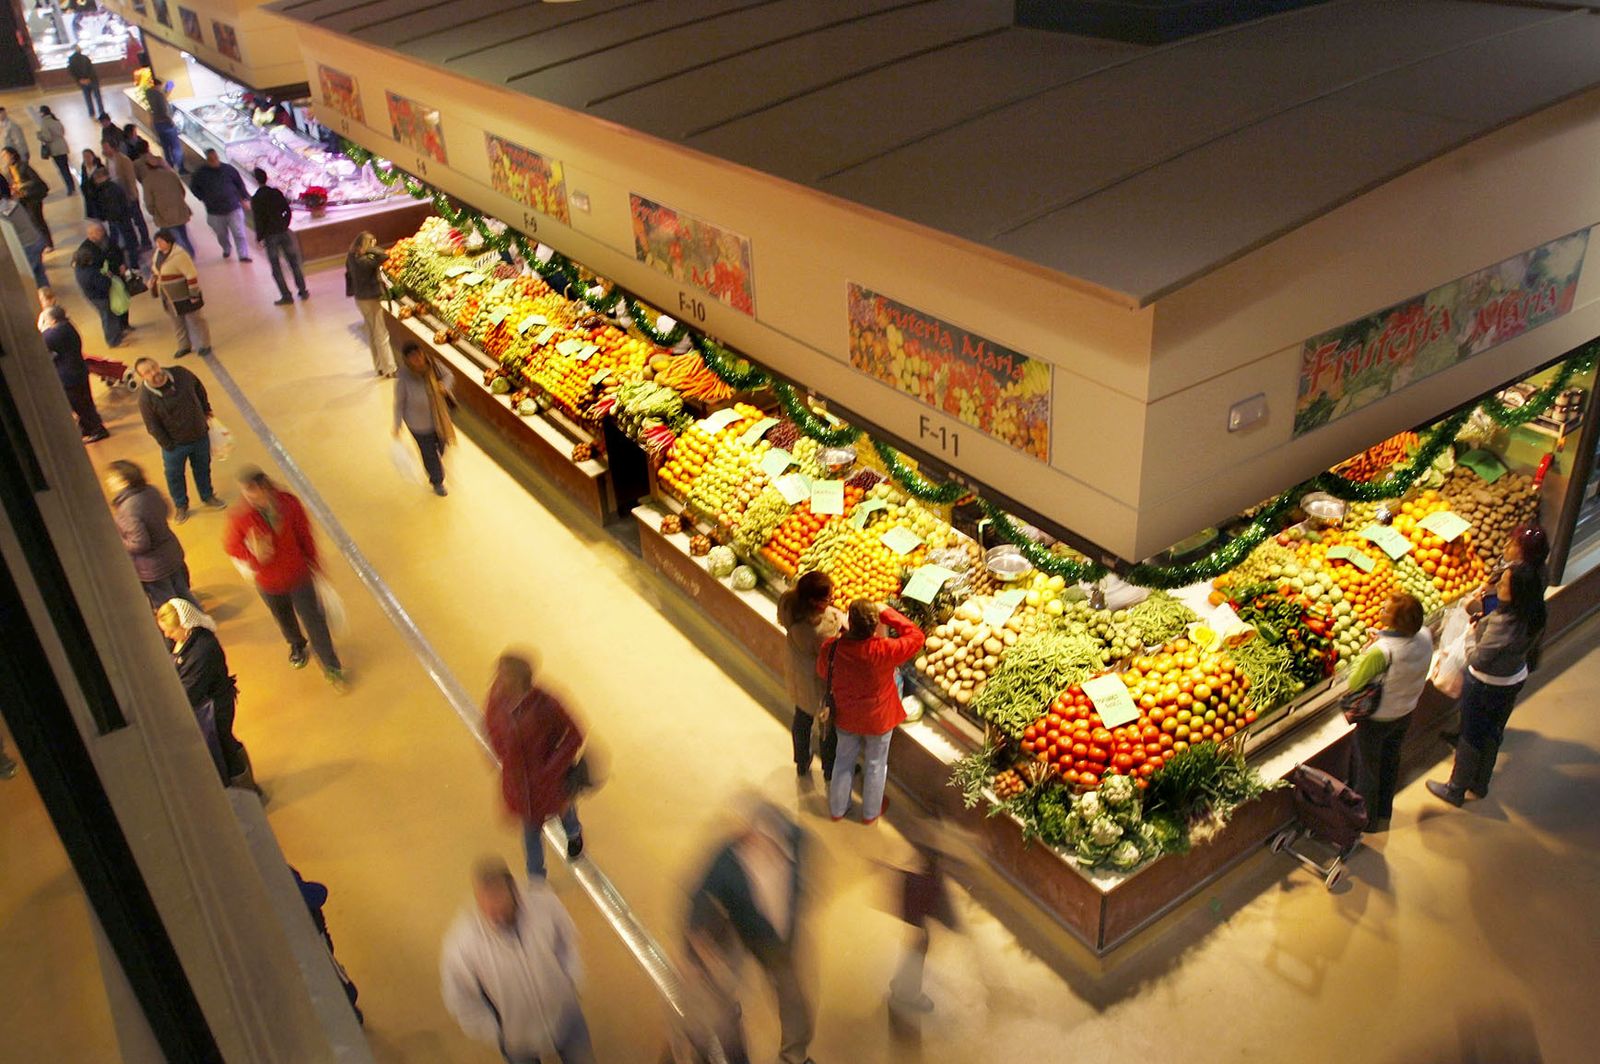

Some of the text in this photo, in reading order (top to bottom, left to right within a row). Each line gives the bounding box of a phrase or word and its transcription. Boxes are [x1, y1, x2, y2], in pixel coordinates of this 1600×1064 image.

[523, 212, 538, 233] F-9
[679, 291, 706, 322] F-10
[919, 414, 960, 458] F-11
